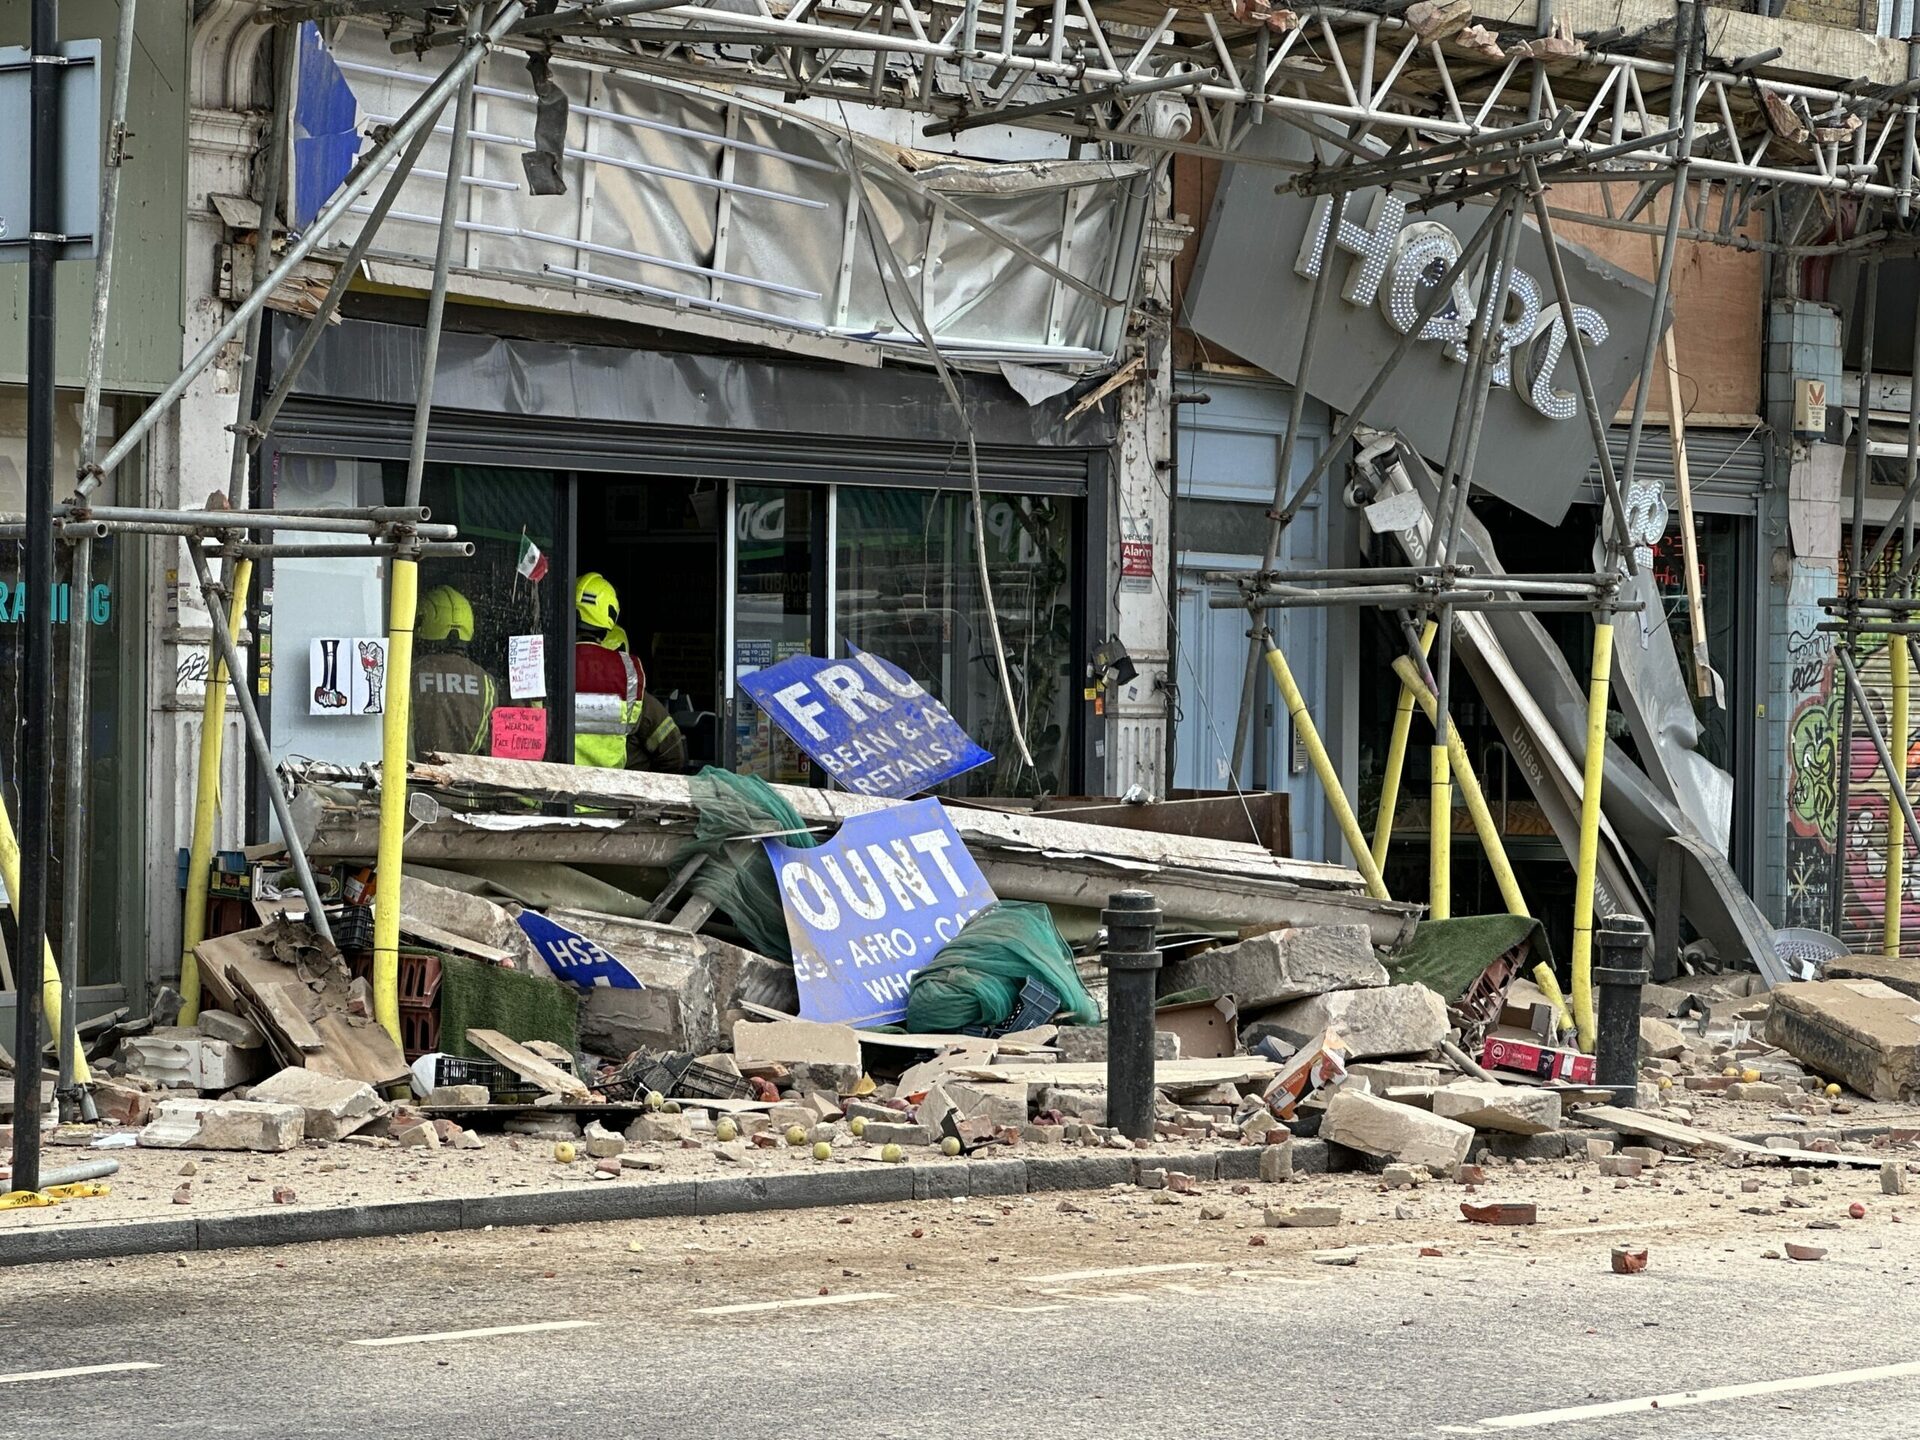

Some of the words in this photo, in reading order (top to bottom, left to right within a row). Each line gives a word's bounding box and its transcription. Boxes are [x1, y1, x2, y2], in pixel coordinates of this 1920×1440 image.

[1123, 544, 1152, 557] Alarm
[418, 671, 480, 696] FIRE
[818, 727, 888, 774] BEAN
[852, 742, 953, 795] RETAILS
[1512, 725, 1545, 787] Unisex
[780, 828, 970, 932] OUNT
[848, 927, 917, 969] AFRO
